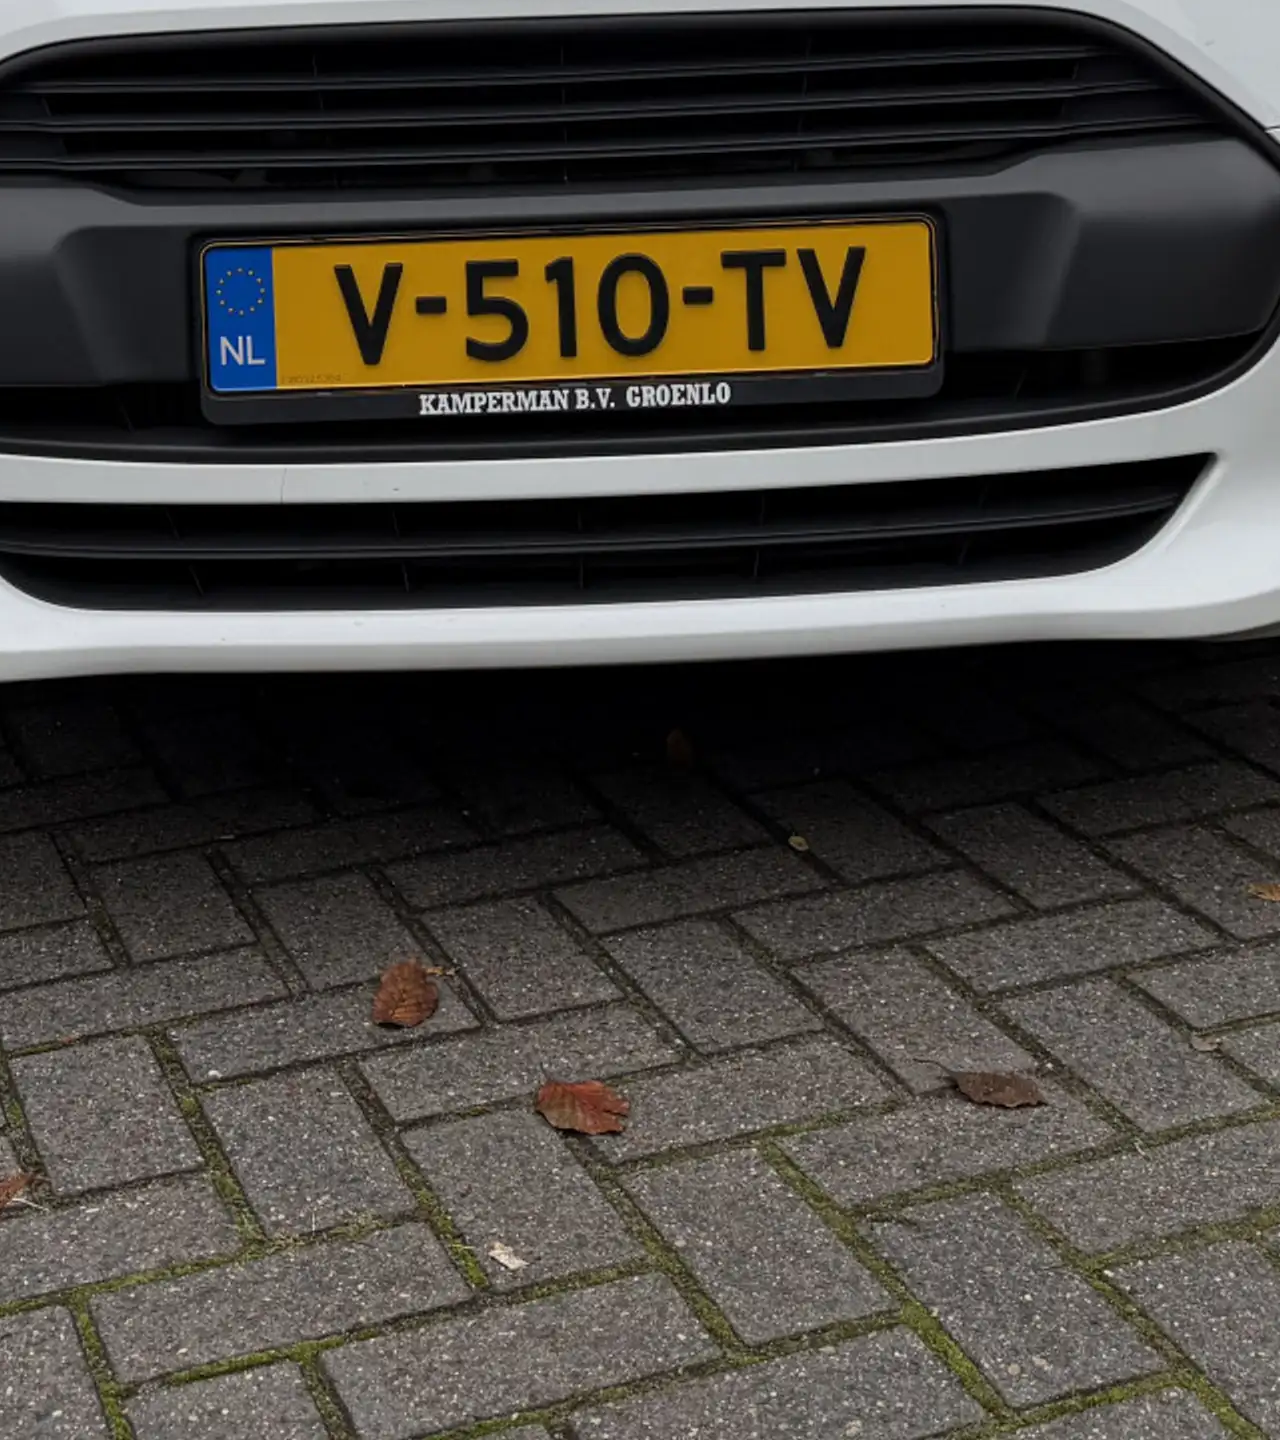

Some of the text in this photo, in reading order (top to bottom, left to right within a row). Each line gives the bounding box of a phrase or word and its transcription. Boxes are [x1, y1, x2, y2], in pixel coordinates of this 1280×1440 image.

[333, 246, 865, 365] V-510-TV
[220, 335, 266, 367] NL
[419, 382, 731, 415] KAMPERMAN B.V. GROENLO
